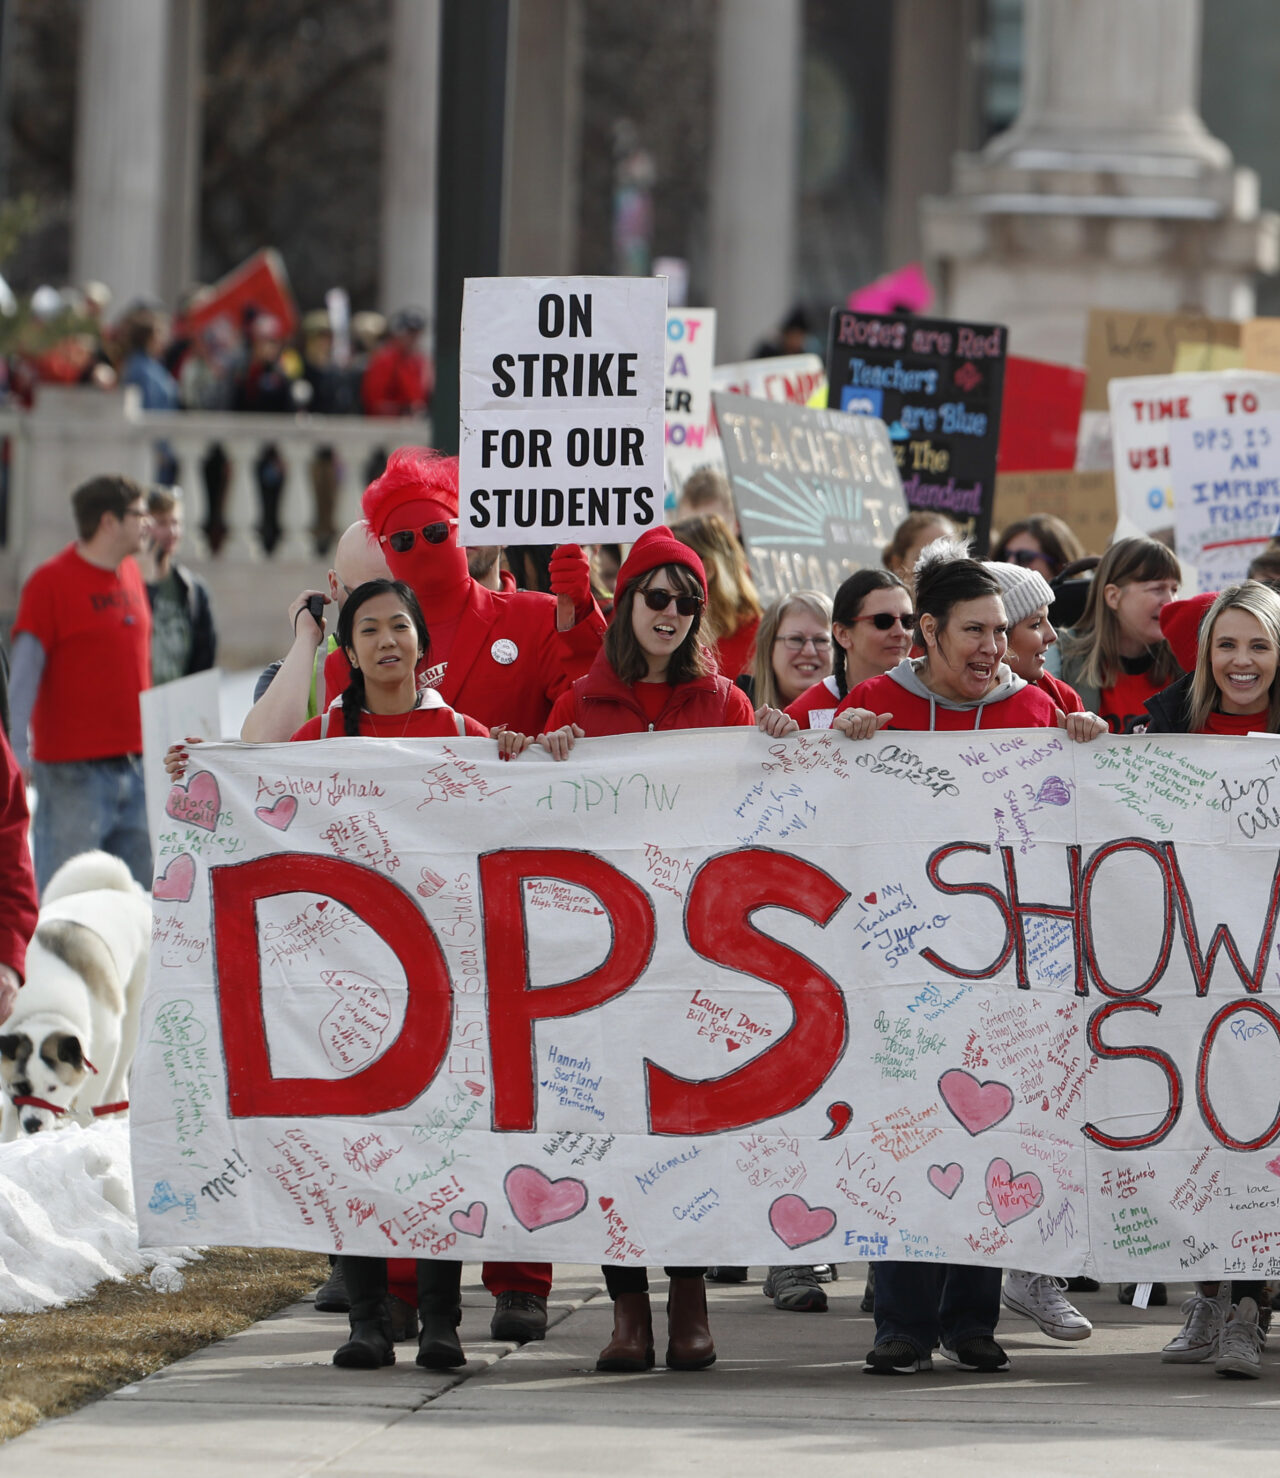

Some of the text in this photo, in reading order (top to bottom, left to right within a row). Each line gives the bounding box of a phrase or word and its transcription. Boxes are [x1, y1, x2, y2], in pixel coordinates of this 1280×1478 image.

[538, 293, 593, 339] ON
[667, 319, 701, 343] OT
[838, 315, 1001, 357] Roses are Red
[491, 352, 638, 398] STRIKE
[670, 353, 688, 377] A
[849, 358, 938, 395] Teachers
[665, 390, 692, 413] ER
[902, 405, 937, 431] are
[939, 402, 987, 436] Blue
[1132, 393, 1258, 422] TIME TO
[481, 426, 645, 469] FOR OUR
[723, 411, 896, 490] TEACHING
[1193, 427, 1271, 450] DPS IS
[1230, 454, 1259, 471] AN
[469, 486, 655, 528] STUDENTS
[958, 737, 1029, 766] We love
[256, 776, 323, 806] Ashley
[533, 881, 571, 896] Colleen
[434, 872, 485, 1075] EAST Social Studies
[208, 844, 853, 1141] DPS,
[686, 1008, 752, 1045] Bill Roberts
[691, 988, 773, 1038] Laurel Davis
[547, 1045, 592, 1072] Hannah
[379, 1175, 465, 1246] PLEASE!
